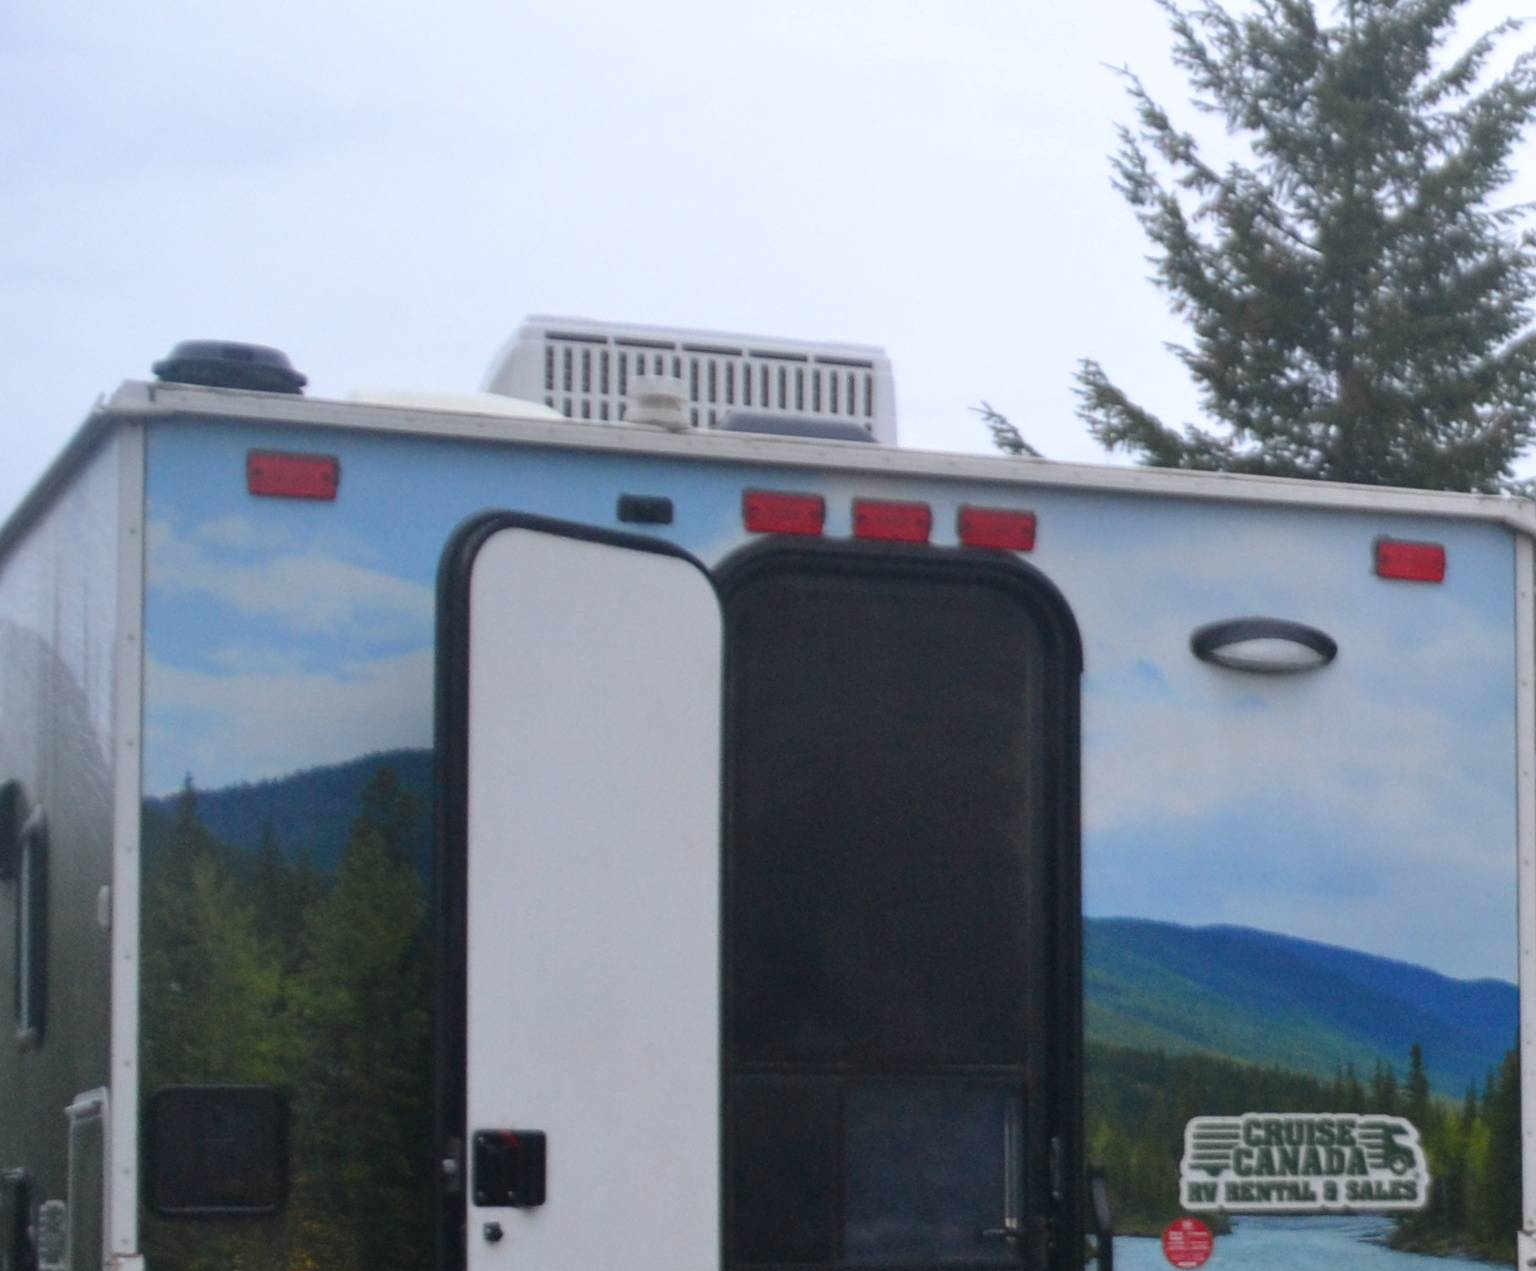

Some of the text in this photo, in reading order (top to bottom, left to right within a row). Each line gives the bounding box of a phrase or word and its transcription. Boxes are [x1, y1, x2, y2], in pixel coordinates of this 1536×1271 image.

[1242, 1117, 1357, 1147] CRUISE
[1232, 1146, 1369, 1177] CANADA
[1187, 1179, 1418, 1203] RV RENTAL & SALES
